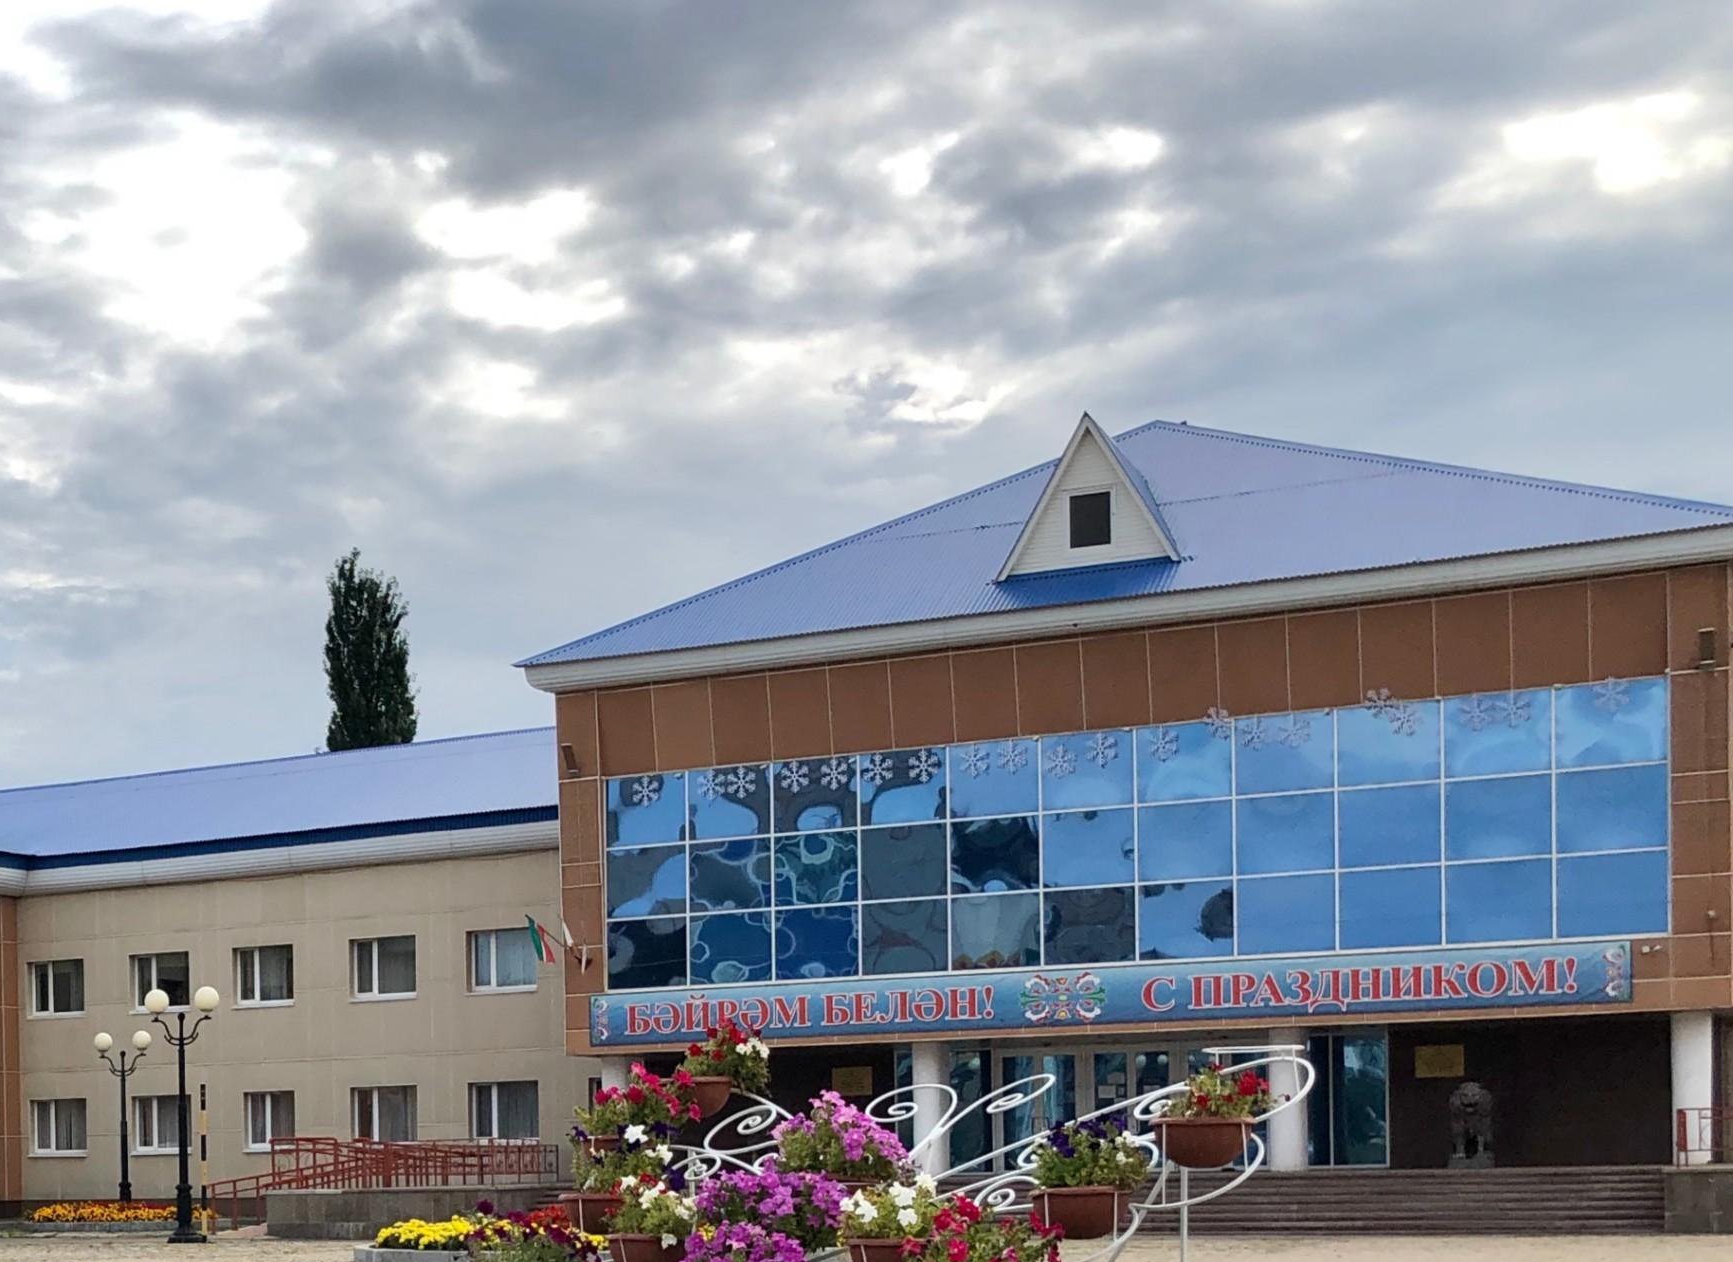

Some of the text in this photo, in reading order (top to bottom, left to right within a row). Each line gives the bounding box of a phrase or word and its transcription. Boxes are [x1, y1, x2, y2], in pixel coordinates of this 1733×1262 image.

[624, 985, 996, 1036] БӘЙРӘМ БЕЛӘН!
[1141, 956, 1578, 1014] С ПРАЗДНИКОМ!
